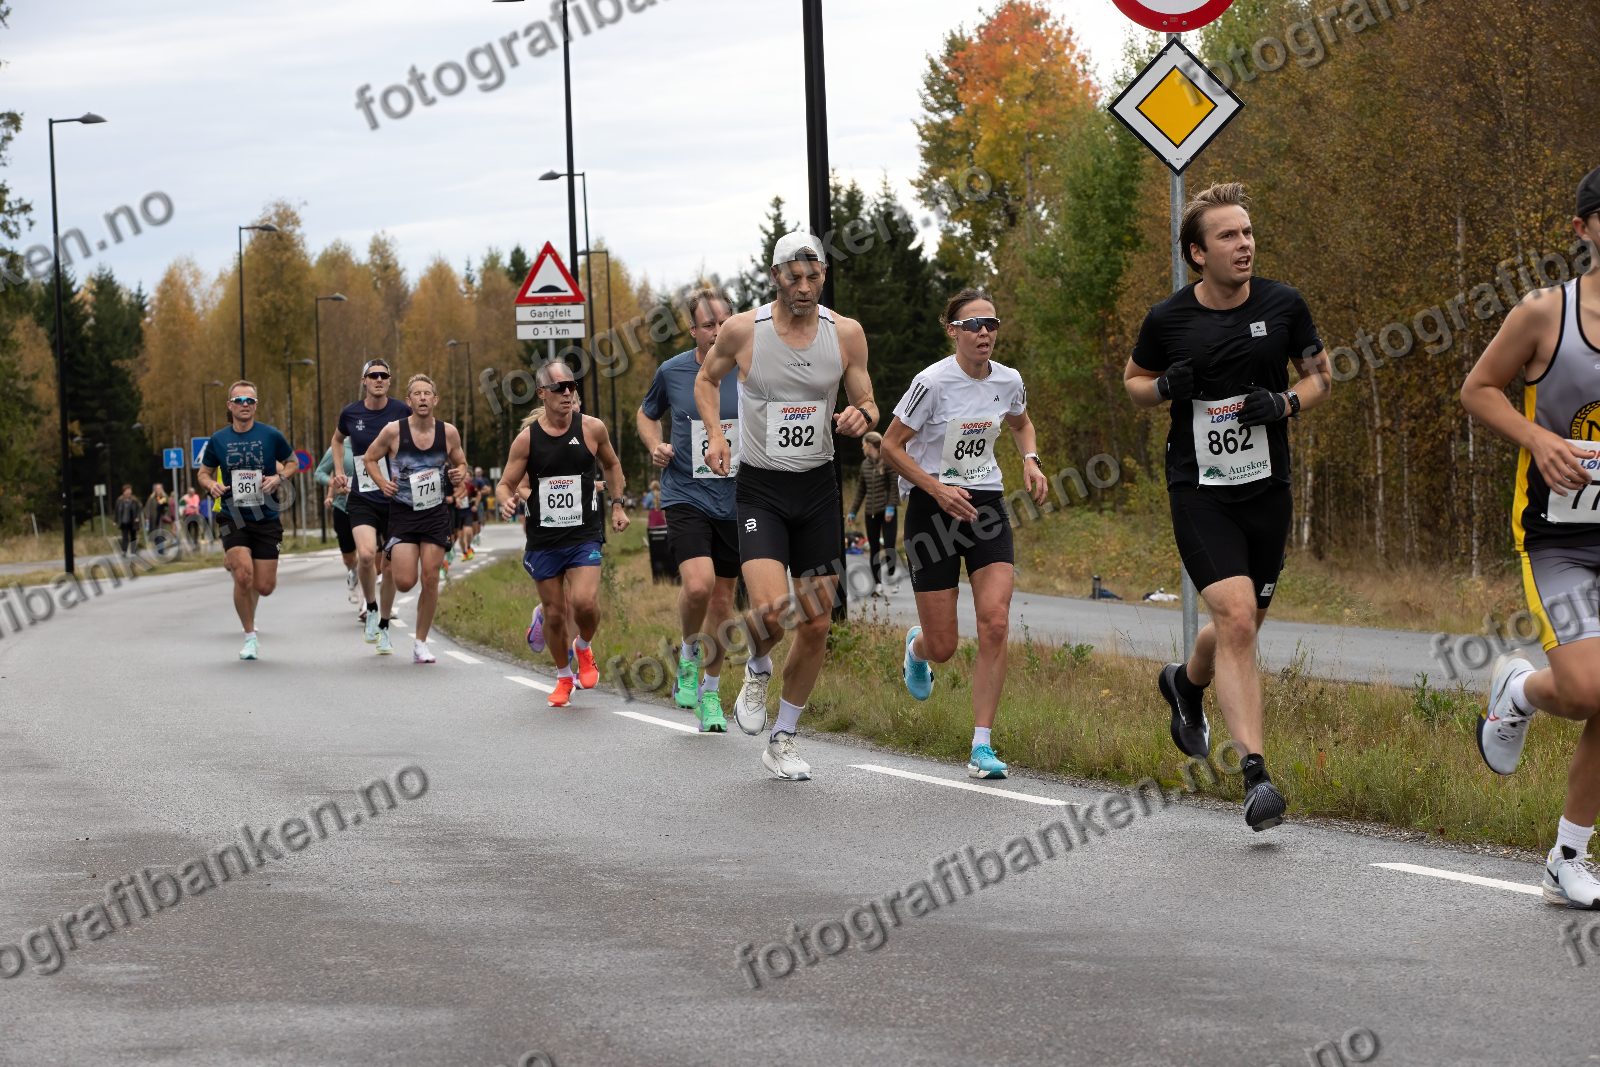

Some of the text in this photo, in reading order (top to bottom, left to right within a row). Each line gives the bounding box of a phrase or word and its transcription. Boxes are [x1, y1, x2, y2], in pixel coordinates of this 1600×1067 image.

[530, 309, 571, 319] Gangfelt
[779, 405, 817, 414] NORGES
[784, 413, 811, 421] LØPET
[778, 425, 815, 448] 382
[1207, 422, 1254, 455] 862
[954, 438, 986, 460] 849
[1228, 459, 1268, 476] Aurskog
[238, 482, 257, 494] 361
[417, 481, 436, 497] 774
[547, 492, 574, 509] 620
